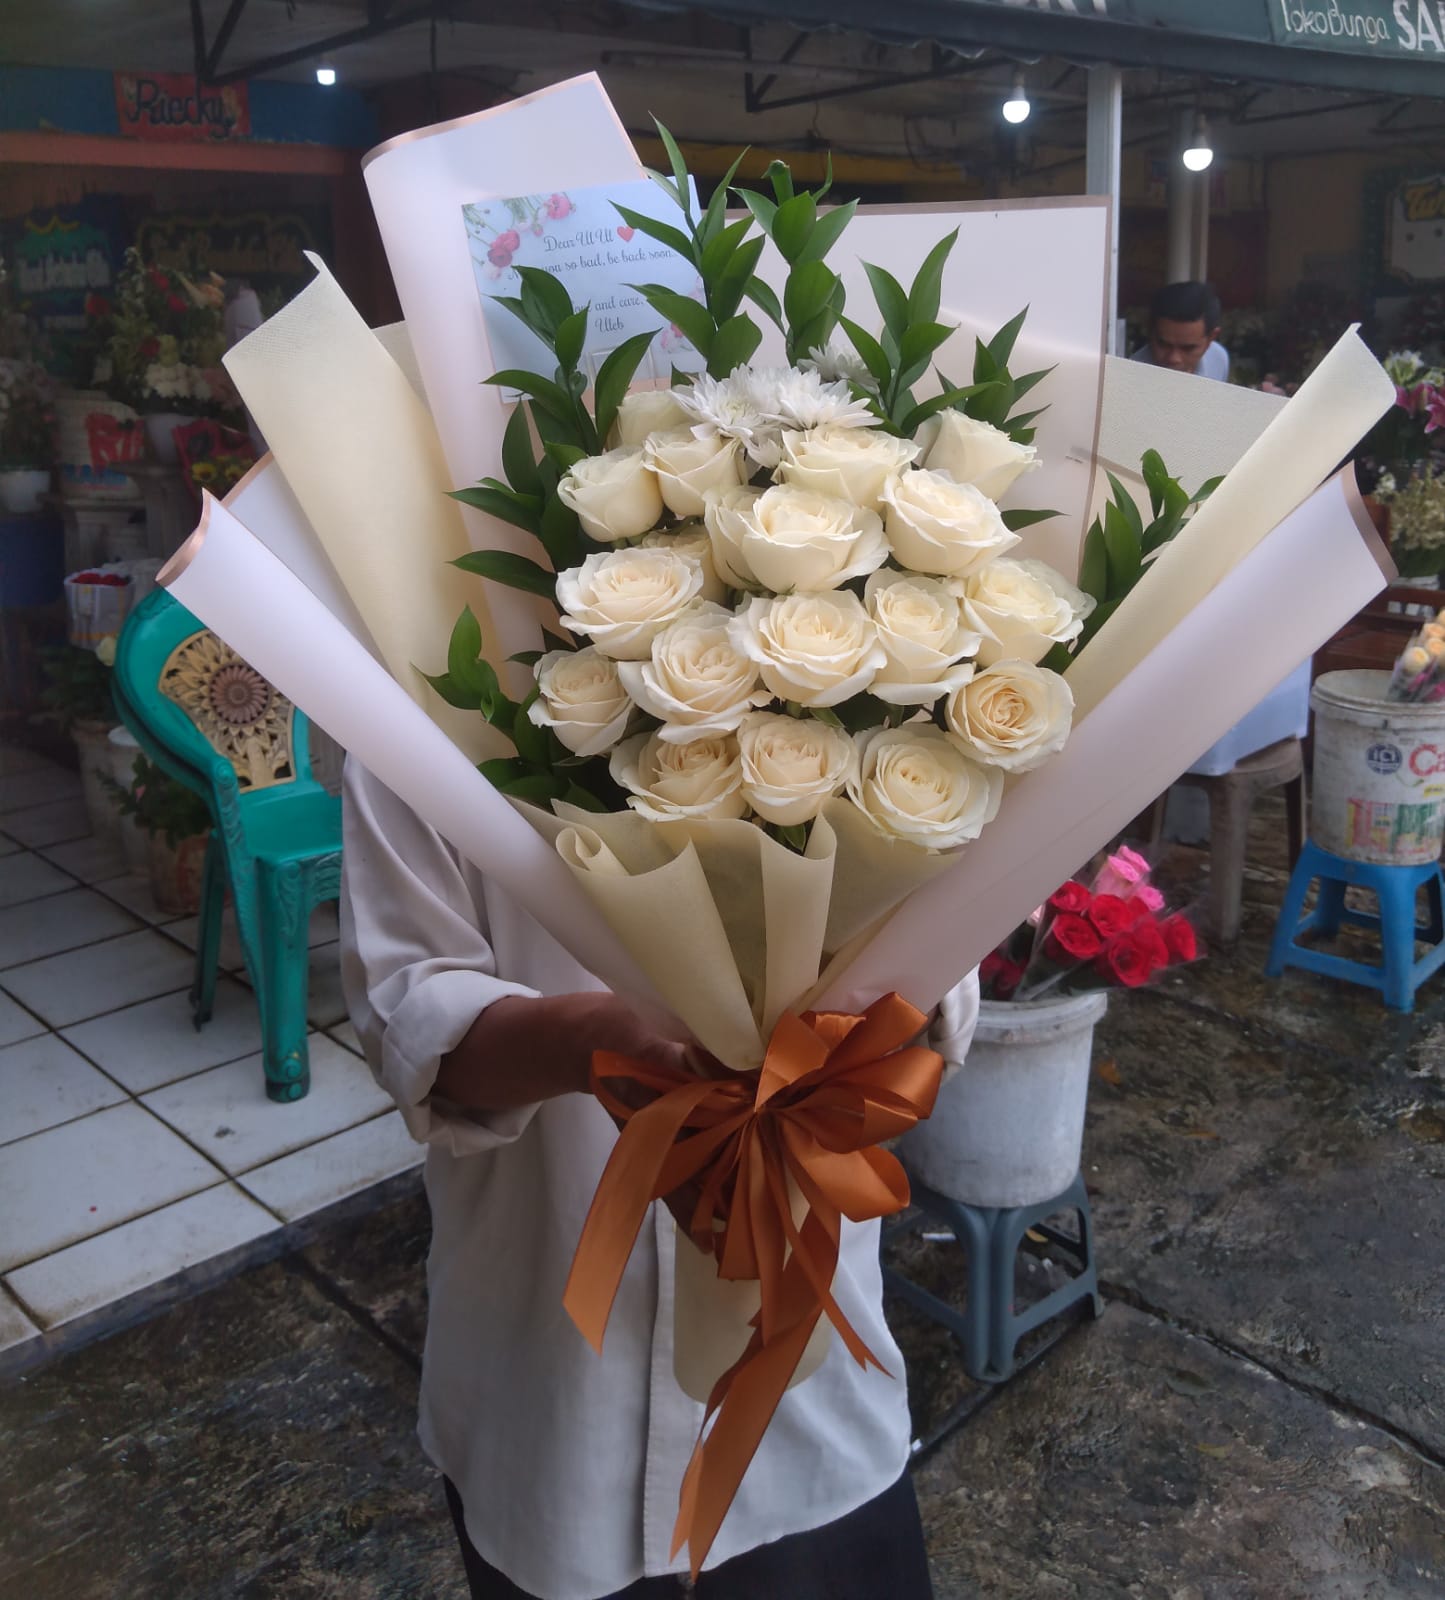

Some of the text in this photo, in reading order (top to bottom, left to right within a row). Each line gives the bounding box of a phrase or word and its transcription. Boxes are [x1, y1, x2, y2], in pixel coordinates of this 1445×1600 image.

[1393, 0, 1445, 52] SA
[543, 234, 575, 252] Dear
[564, 261, 578, 271] so
[580, 255, 605, 269] bad,
[607, 251, 621, 264] be
[622, 248, 647, 262] back
[595, 296, 616, 311] and
